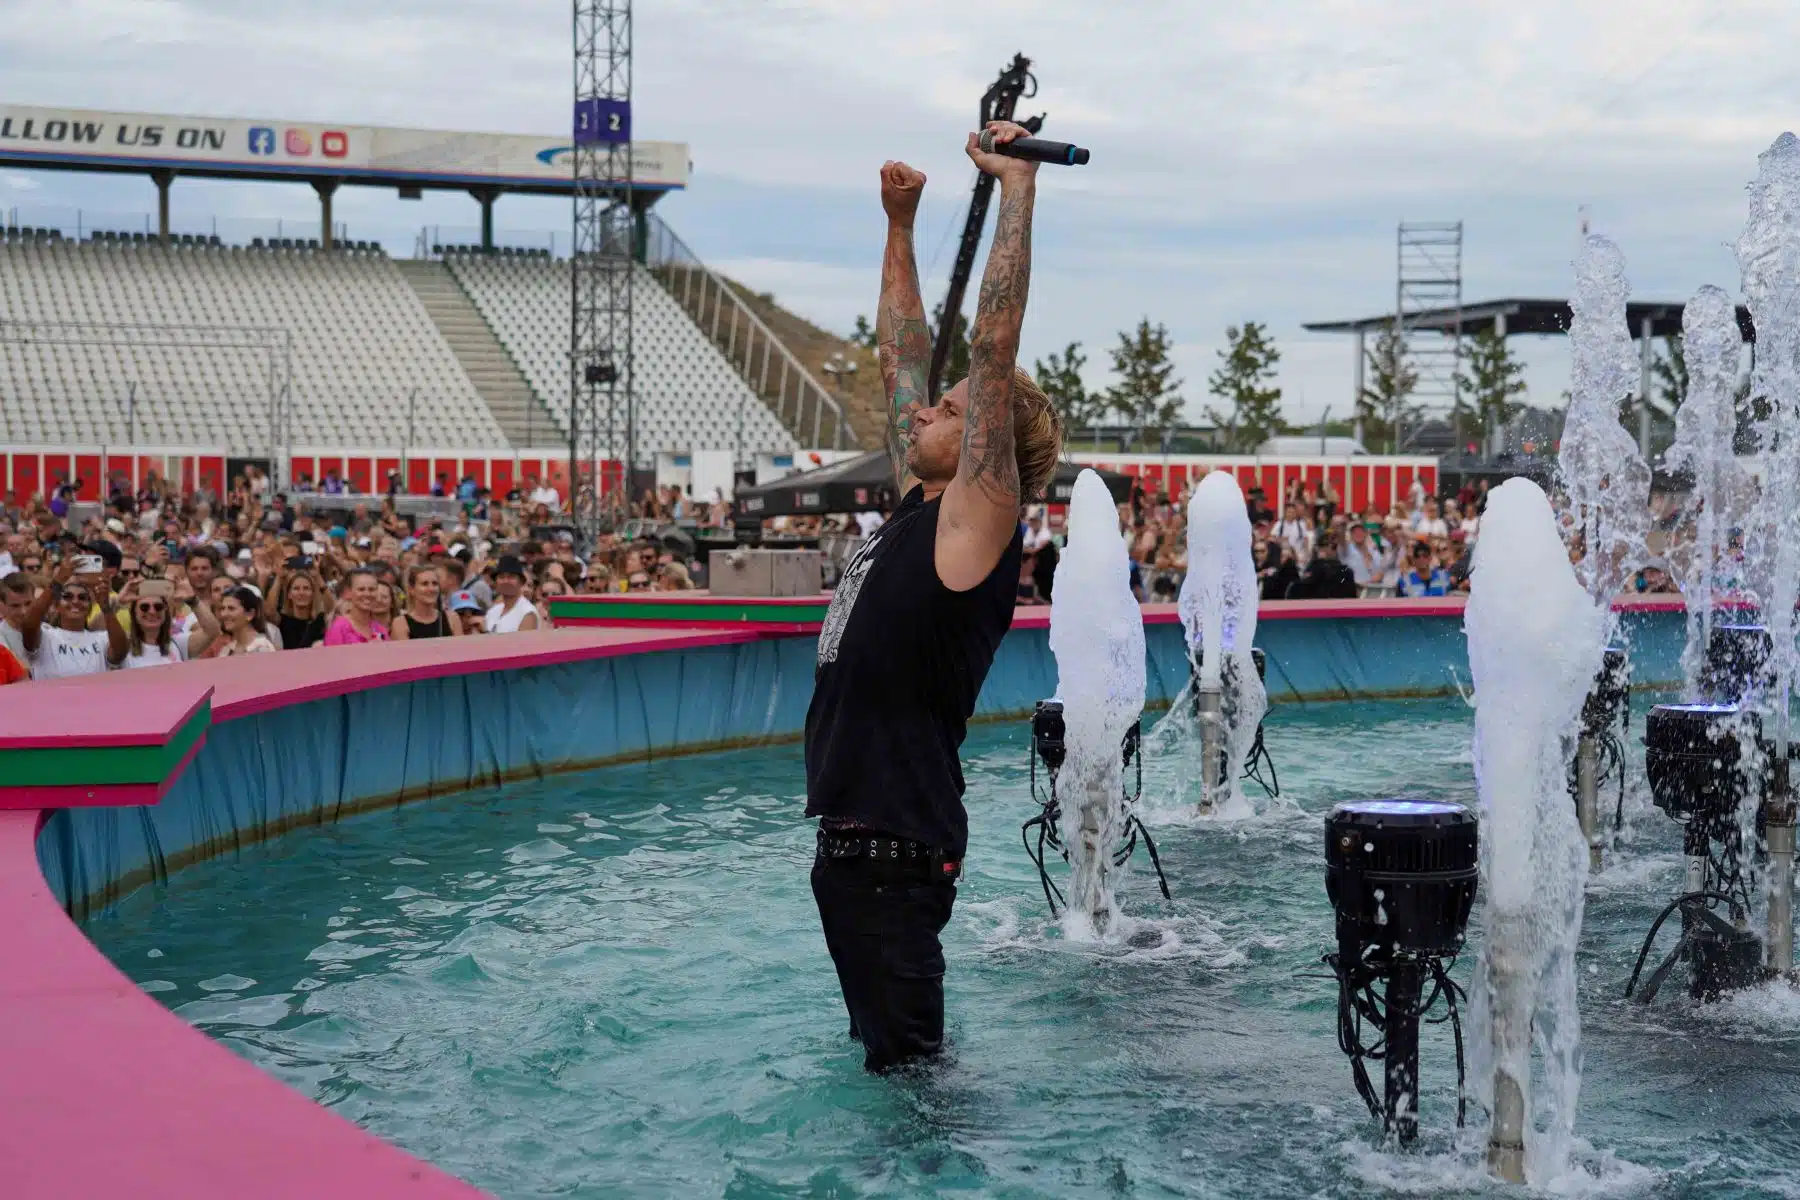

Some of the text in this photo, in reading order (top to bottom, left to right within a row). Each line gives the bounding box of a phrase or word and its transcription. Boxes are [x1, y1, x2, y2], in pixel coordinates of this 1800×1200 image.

[1, 117, 104, 144] LLOW
[116, 124, 164, 147] US
[175, 126, 226, 150] ON
[609, 113, 621, 131] 2
